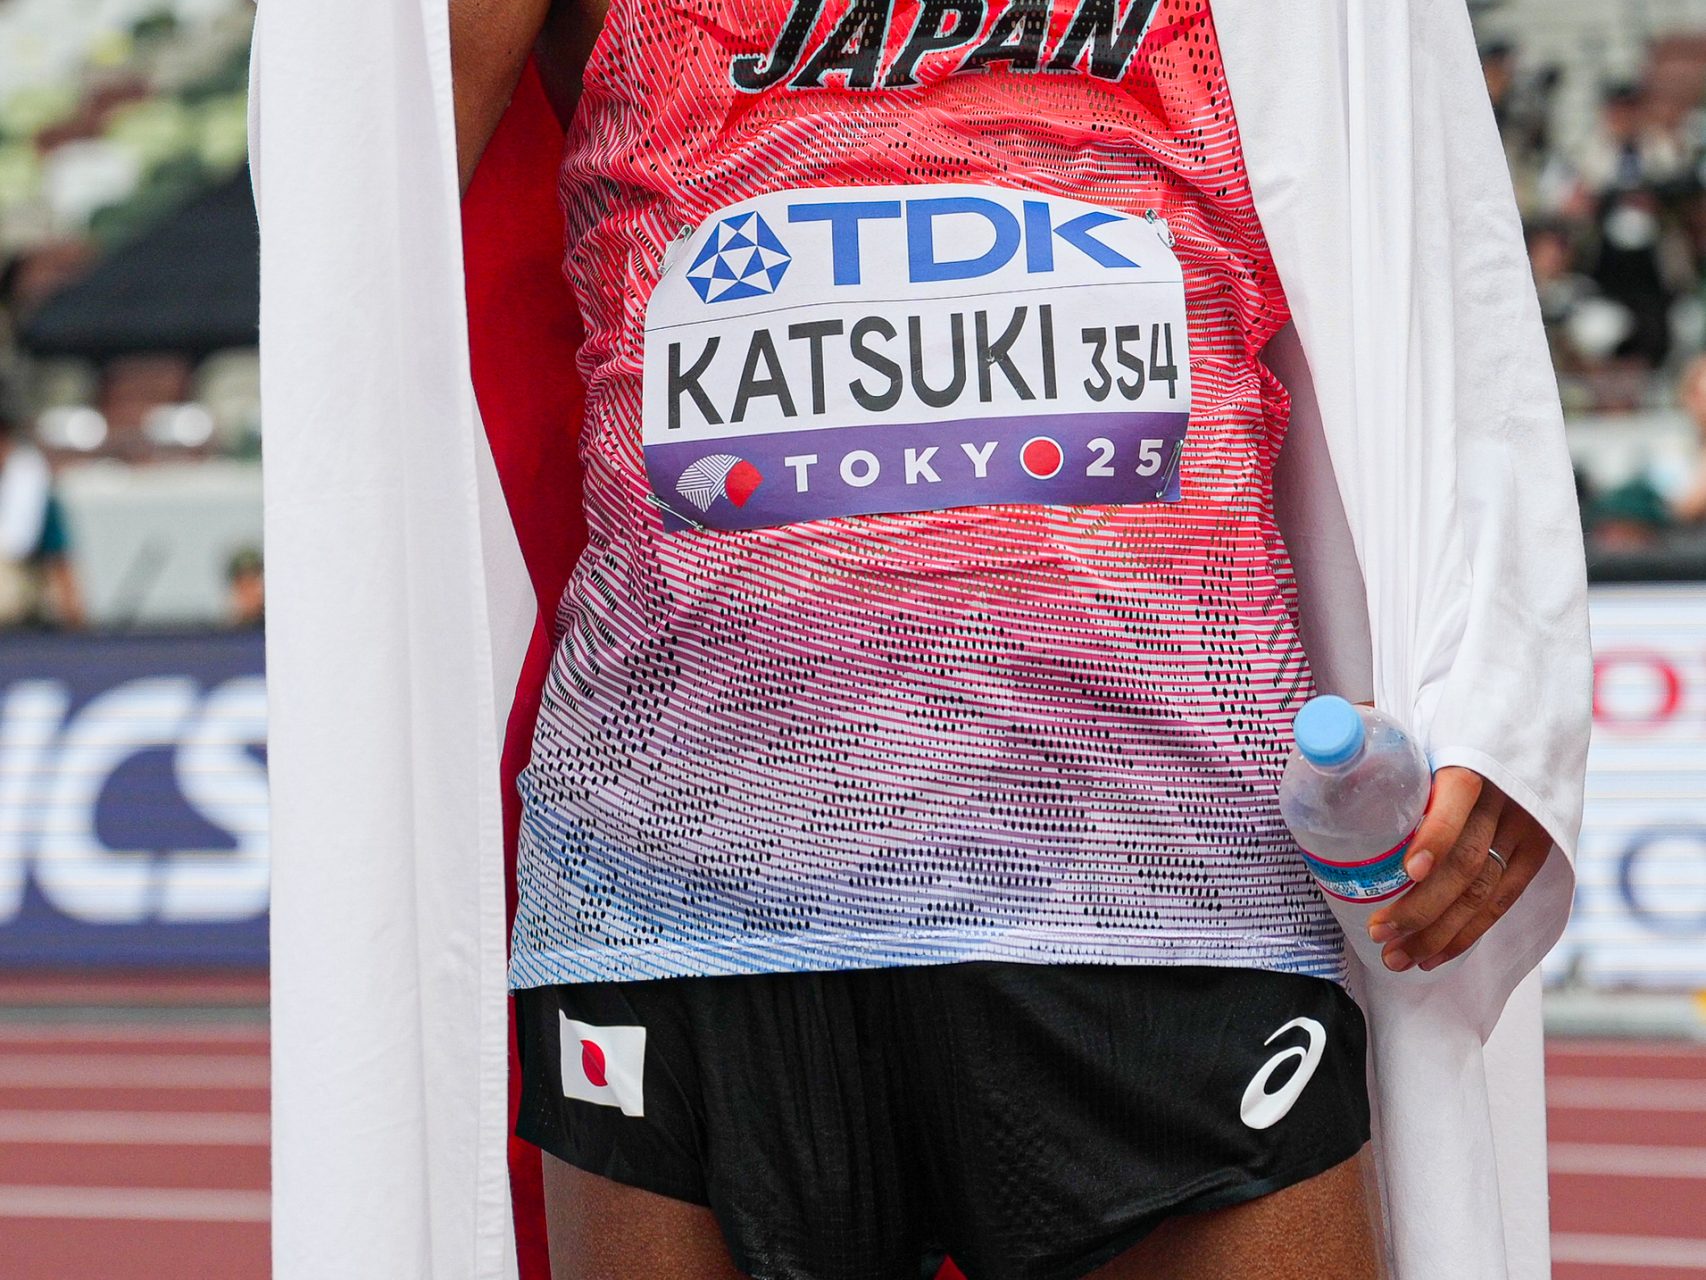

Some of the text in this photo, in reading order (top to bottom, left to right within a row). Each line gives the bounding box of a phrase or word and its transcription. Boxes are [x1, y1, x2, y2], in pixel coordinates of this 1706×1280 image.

[787, 196, 1142, 287] TDK
[667, 304, 1179, 430] KATSUKI 354
